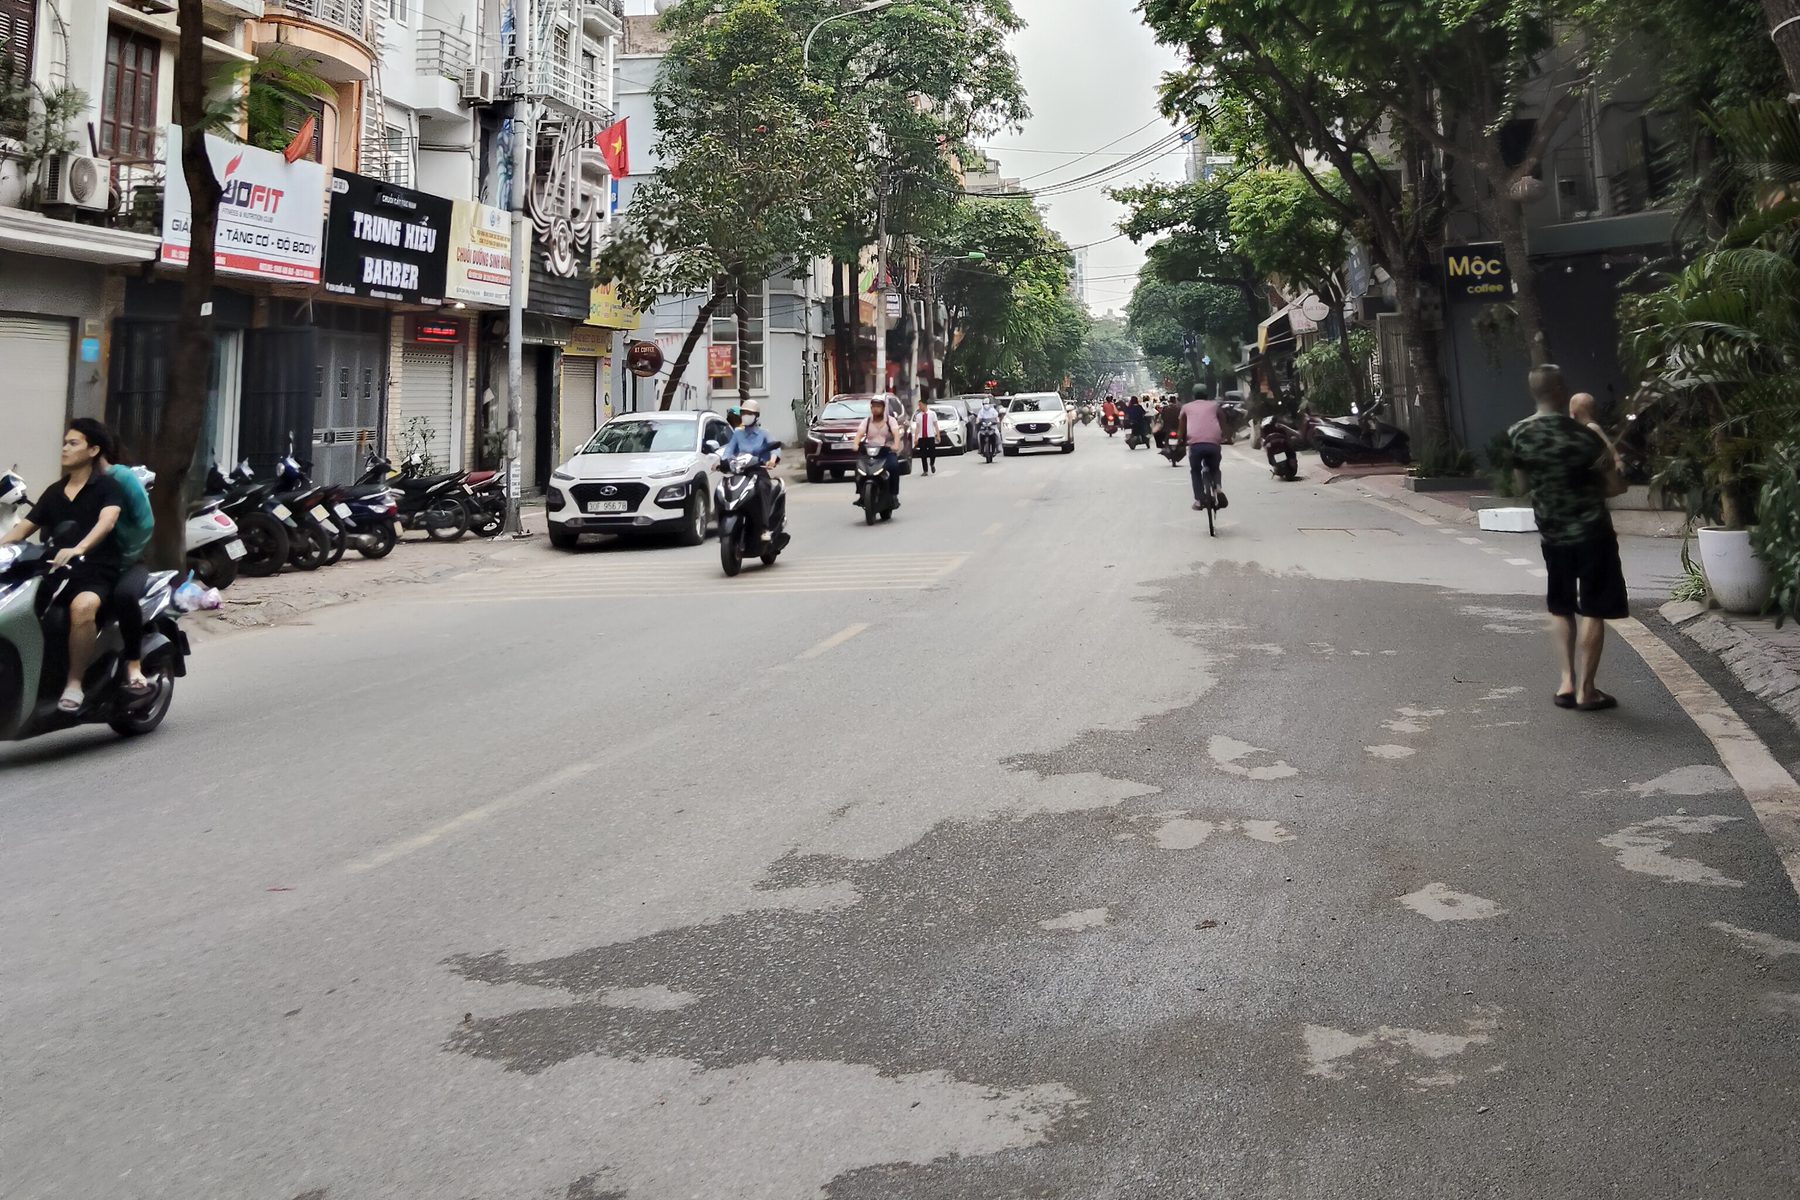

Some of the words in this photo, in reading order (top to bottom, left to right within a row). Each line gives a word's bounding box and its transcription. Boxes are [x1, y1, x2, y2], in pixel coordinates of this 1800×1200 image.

[171, 217, 192, 233] GIẢ
[277, 236, 290, 253] ĐỘ
[292, 241, 316, 255] BODY
[353, 210, 402, 247] TRUNG
[404, 215, 438, 253] HIẾU
[362, 256, 419, 291] BARBER
[1448, 255, 1502, 280] Mộc
